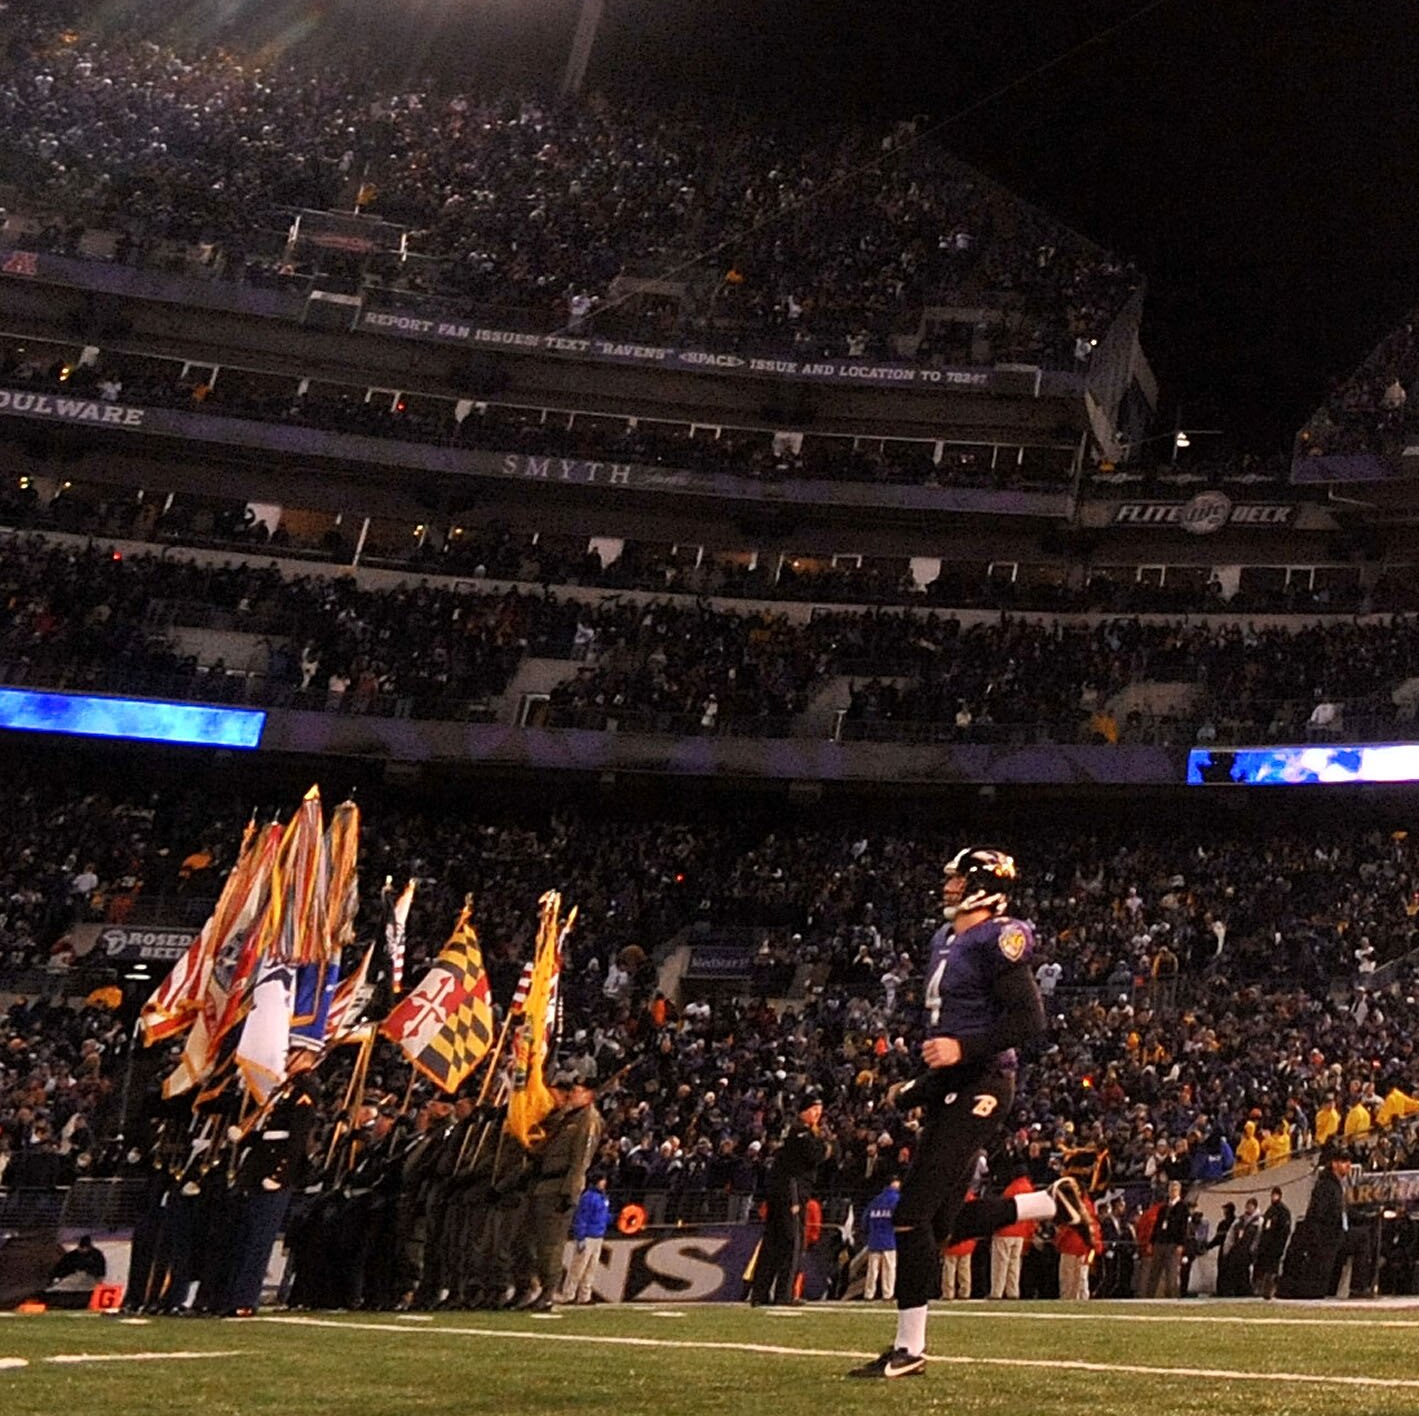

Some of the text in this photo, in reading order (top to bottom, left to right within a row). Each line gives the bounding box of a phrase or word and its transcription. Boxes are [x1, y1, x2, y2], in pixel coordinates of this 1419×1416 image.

[364, 311, 433, 332] REPORT
[438, 323, 470, 340] FAN
[542, 337, 590, 352] TEXT
[749, 359, 798, 374] ISSUE
[802, 363, 835, 377] AND
[839, 365, 916, 381] LOCATION
[919, 370, 942, 382] TO
[502, 454, 632, 484] SMYTH
[1115, 505, 1180, 523] FLITE
[1229, 506, 1293, 523] DECK
[98, 1289, 117, 1308] G
